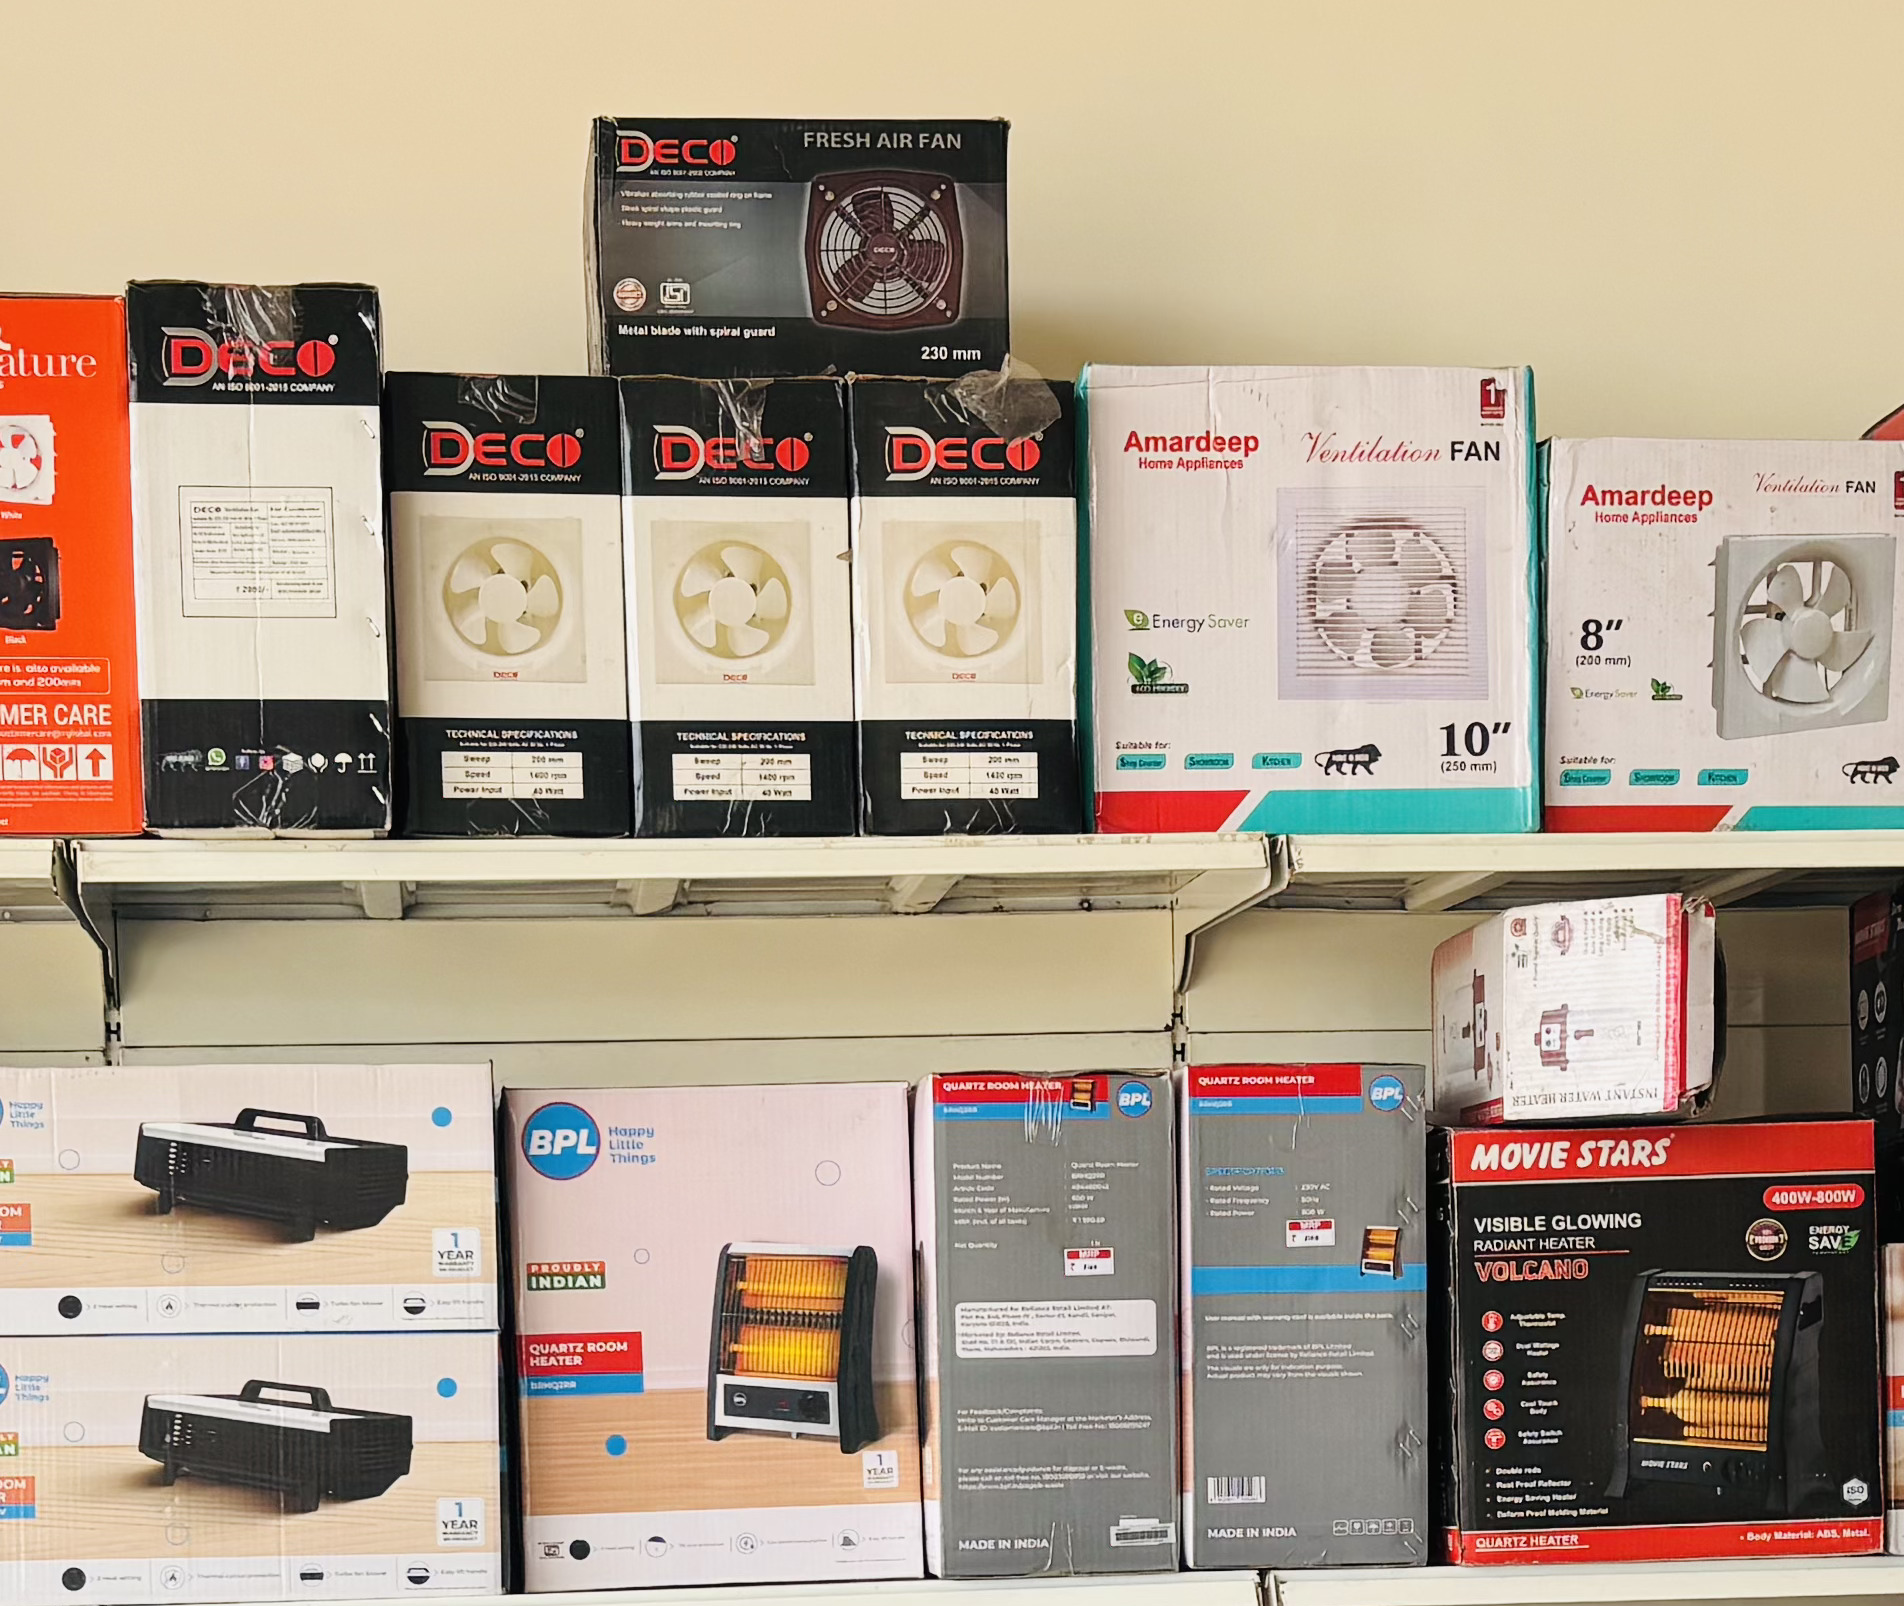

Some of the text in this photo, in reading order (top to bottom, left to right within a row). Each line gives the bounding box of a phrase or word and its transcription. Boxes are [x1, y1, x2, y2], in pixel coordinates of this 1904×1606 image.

[804, 133, 961, 149] FRESH AIR FAN
[616, 130, 733, 172] DECO
[618, 324, 775, 338] Metal blade with spiral guard
[921, 346, 981, 360] 230 mm
[1123, 430, 1259, 458] Amardeep
[1302, 431, 1500, 464] Ventilation FAN
[886, 426, 1042, 482] DECO
[1139, 457, 1243, 471] Home Appliances
[1152, 614, 1249, 631] Energy Saver
[54, 704, 111, 726] CARE
[1441, 760, 1496, 773] (250 mm)
[609, 1126, 654, 1139] Happy
[529, 1129, 596, 1156] BPL
[609, 1152, 656, 1164] Things
[1471, 1138, 1670, 1170] MOVIE STARS
[1771, 1190, 1855, 1204] 400W-800W
[1474, 1213, 1642, 1233] VISIBLE GLOWING
[1474, 1237, 1595, 1251] RADIANT HEATER
[531, 1263, 600, 1272] PROUDLY
[1475, 1259, 1588, 1282] VOLCANO
[531, 1275, 602, 1289] INDIAN
[530, 1341, 627, 1355] QUARTZ ROOM
[530, 1355, 582, 1367] HEATER
[1208, 1527, 1297, 1539] MADE IN INDIA
[1529, 1535, 1578, 1546] HEATER
